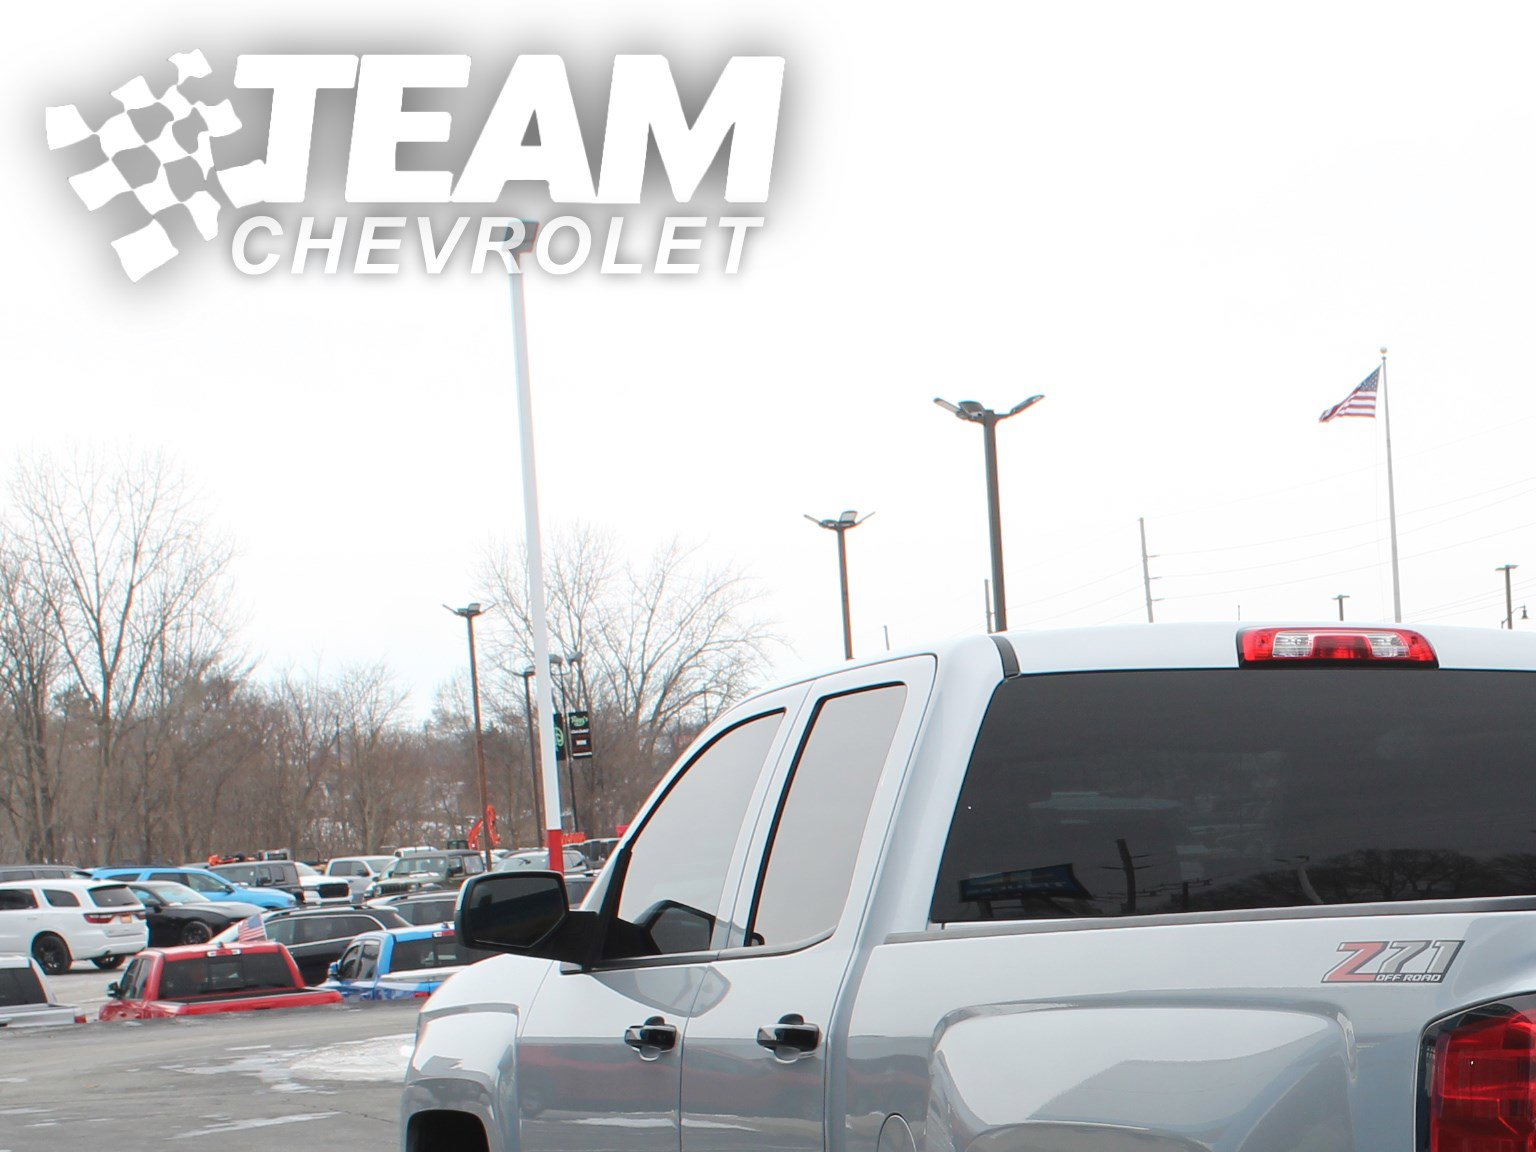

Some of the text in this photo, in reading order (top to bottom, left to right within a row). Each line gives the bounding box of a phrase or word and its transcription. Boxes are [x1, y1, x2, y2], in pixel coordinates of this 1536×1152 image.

[1321, 940, 1465, 983] Z71
[1375, 974, 1442, 982] OFF ROAD
